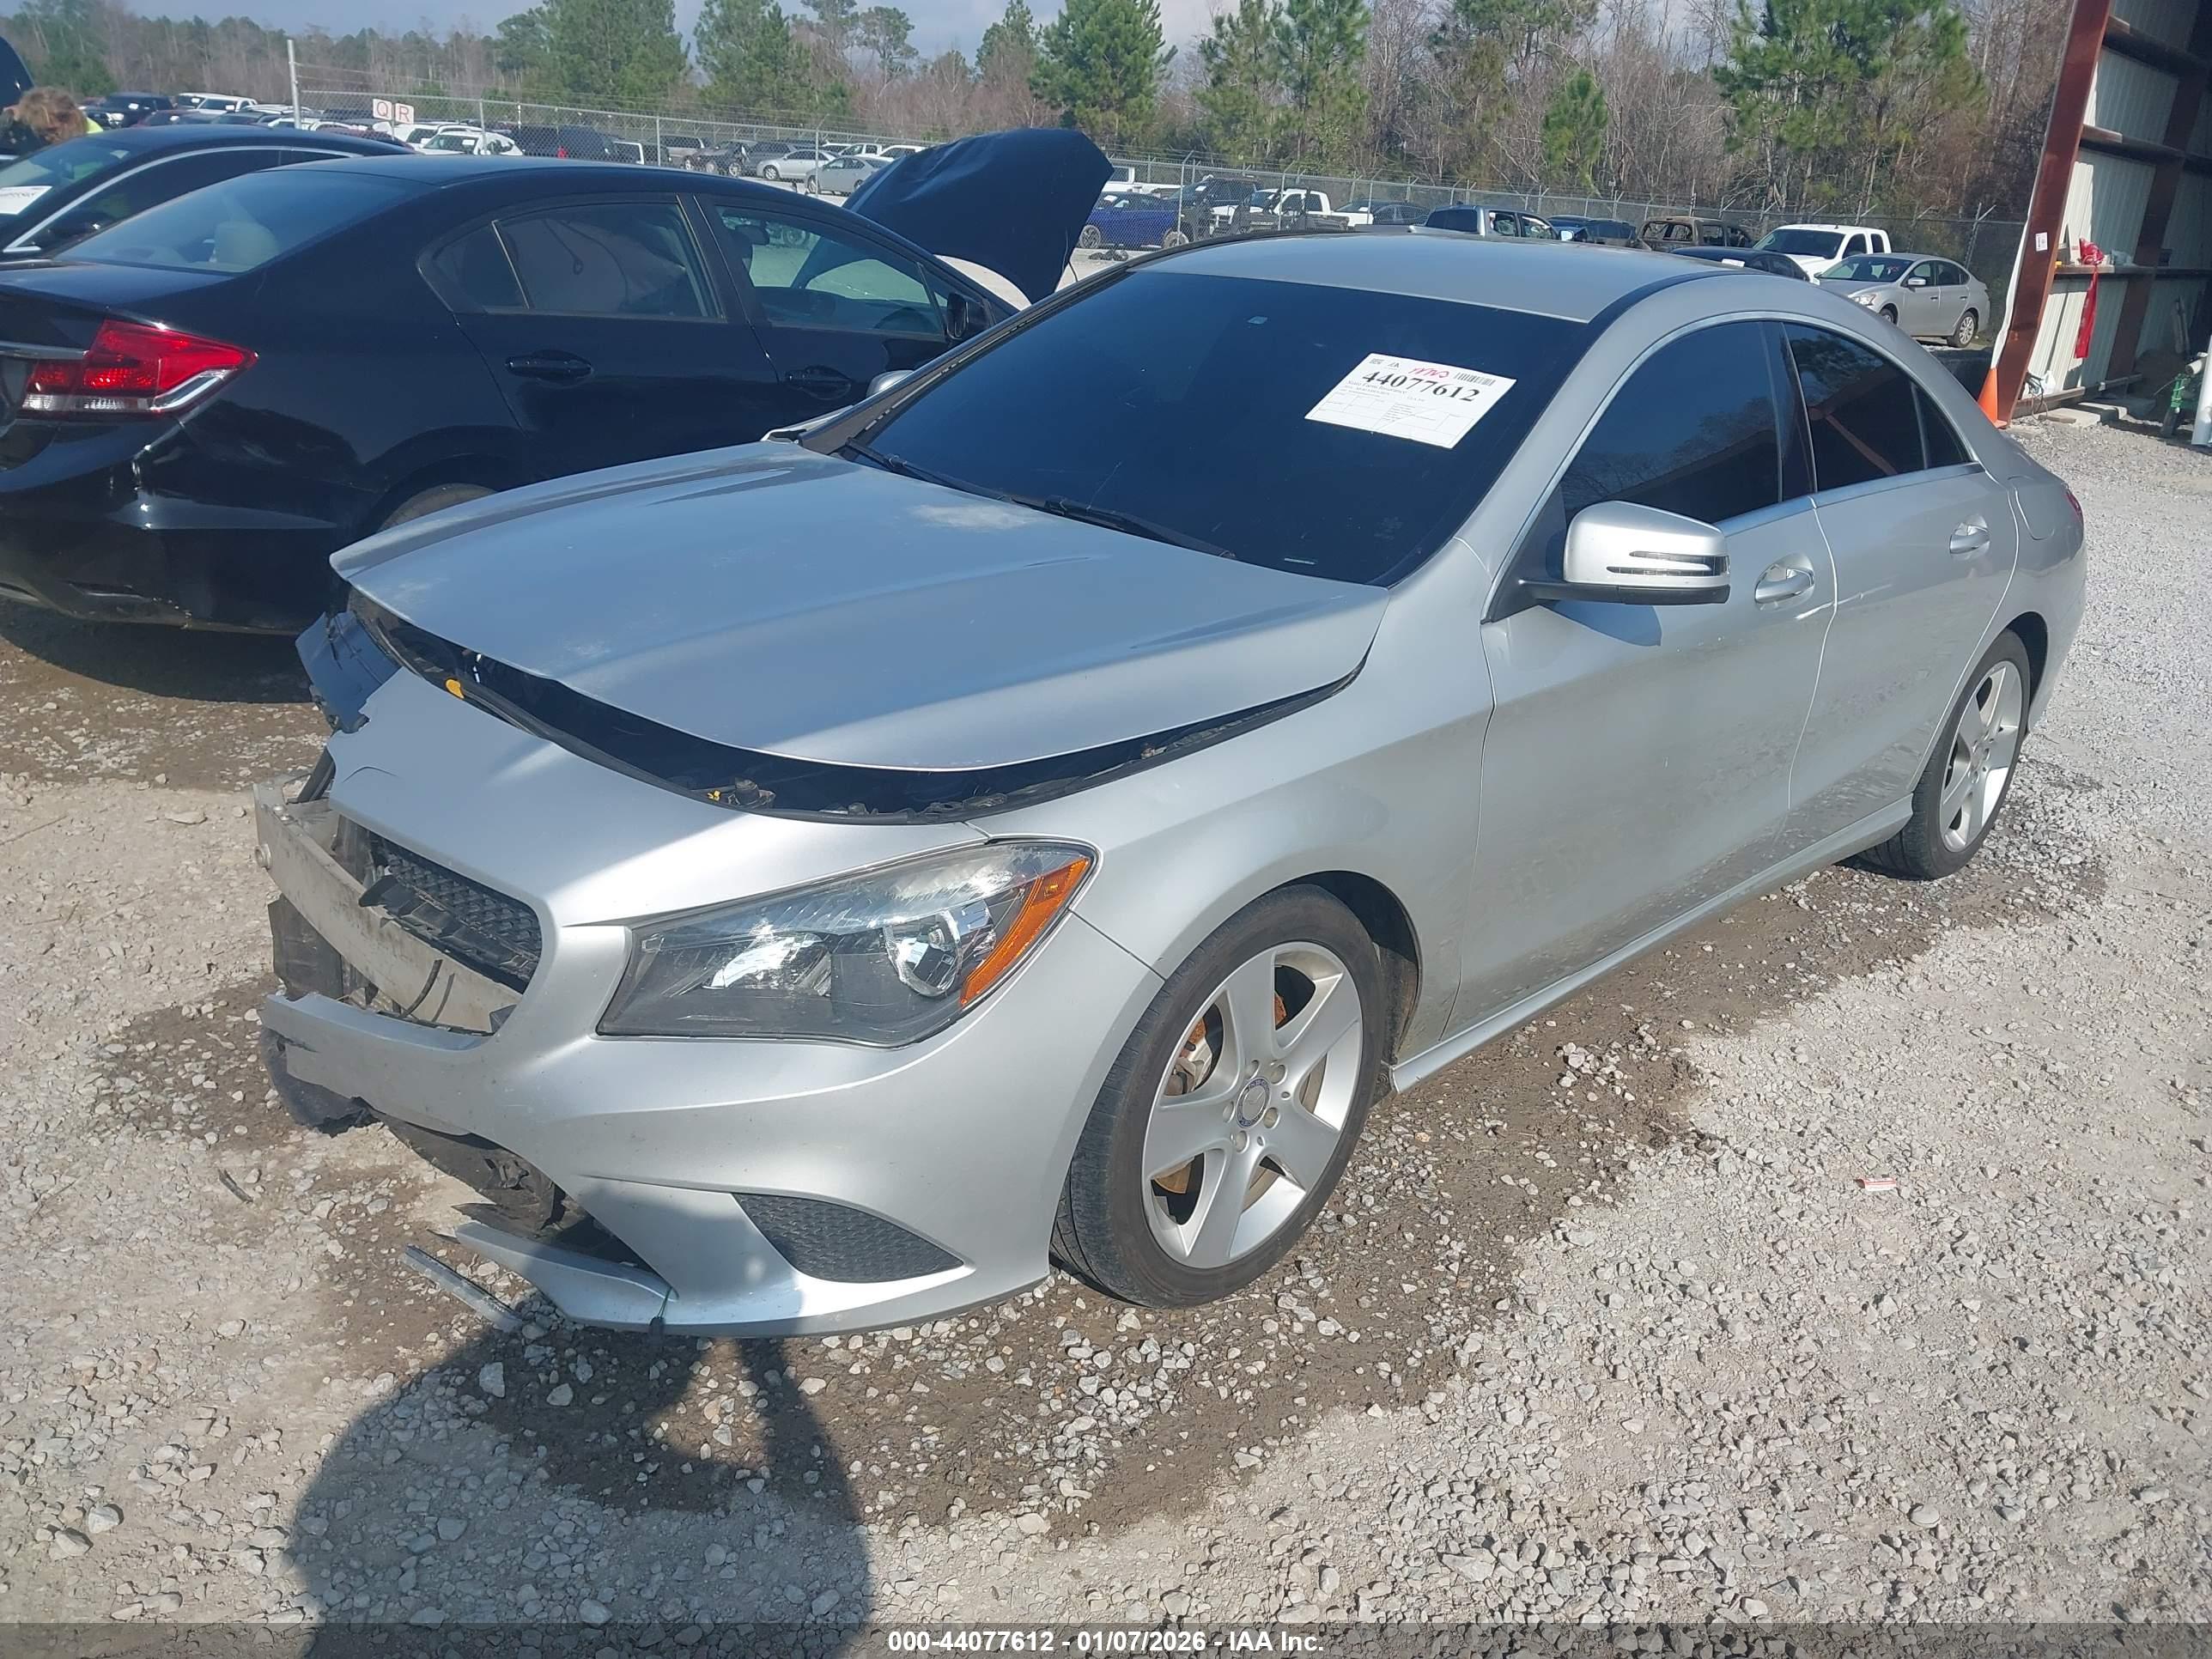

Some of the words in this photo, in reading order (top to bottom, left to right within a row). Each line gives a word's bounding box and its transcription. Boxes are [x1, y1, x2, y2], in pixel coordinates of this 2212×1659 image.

[376, 100, 389, 118] Q
[398, 106, 410, 122] R
[1362, 371, 1480, 402] 44077612
